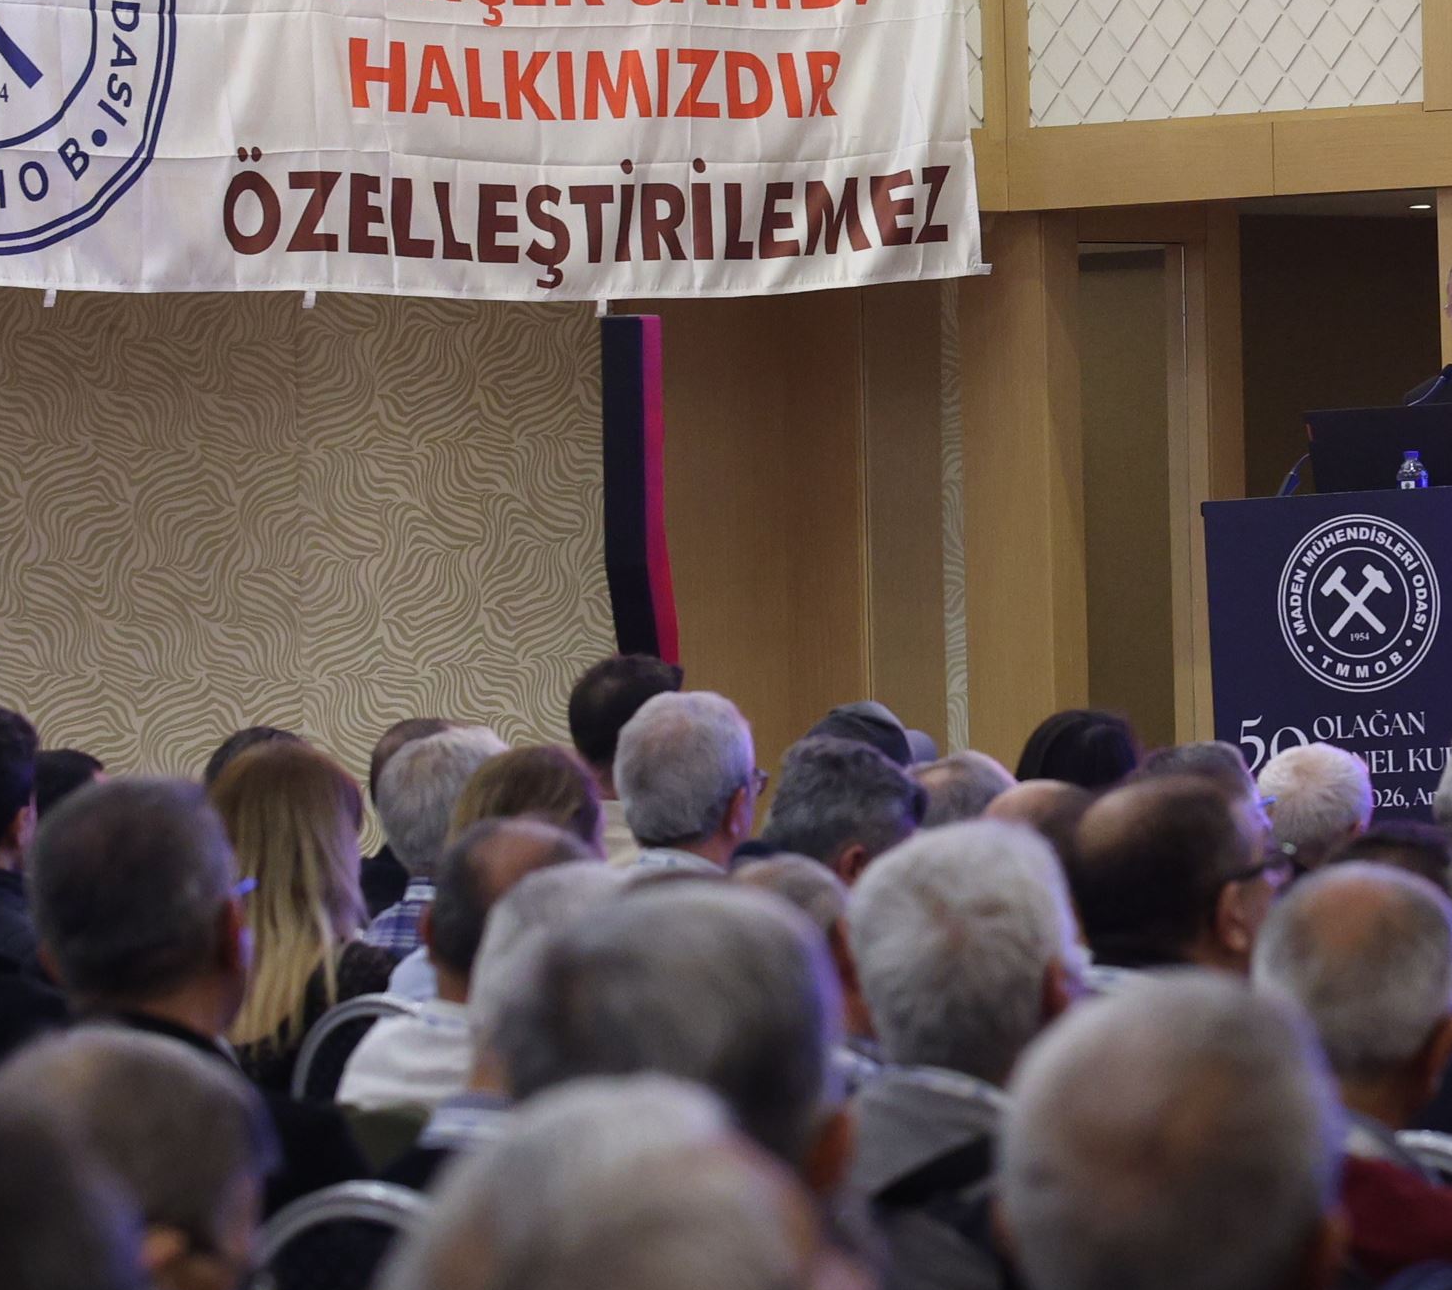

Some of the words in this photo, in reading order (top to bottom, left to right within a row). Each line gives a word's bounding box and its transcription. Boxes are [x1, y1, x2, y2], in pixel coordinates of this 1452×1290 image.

[349, 37, 842, 122] HALKIMIZDIR
[223, 146, 950, 289] ÖZELLEŞTİRİLEMEZ
[1291, 568, 1306, 636] MADEN
[1412, 575, 1428, 632] ODASI
[1321, 651, 1403, 679] TMMOB
[1313, 710, 1426, 740] OLAĞAN
